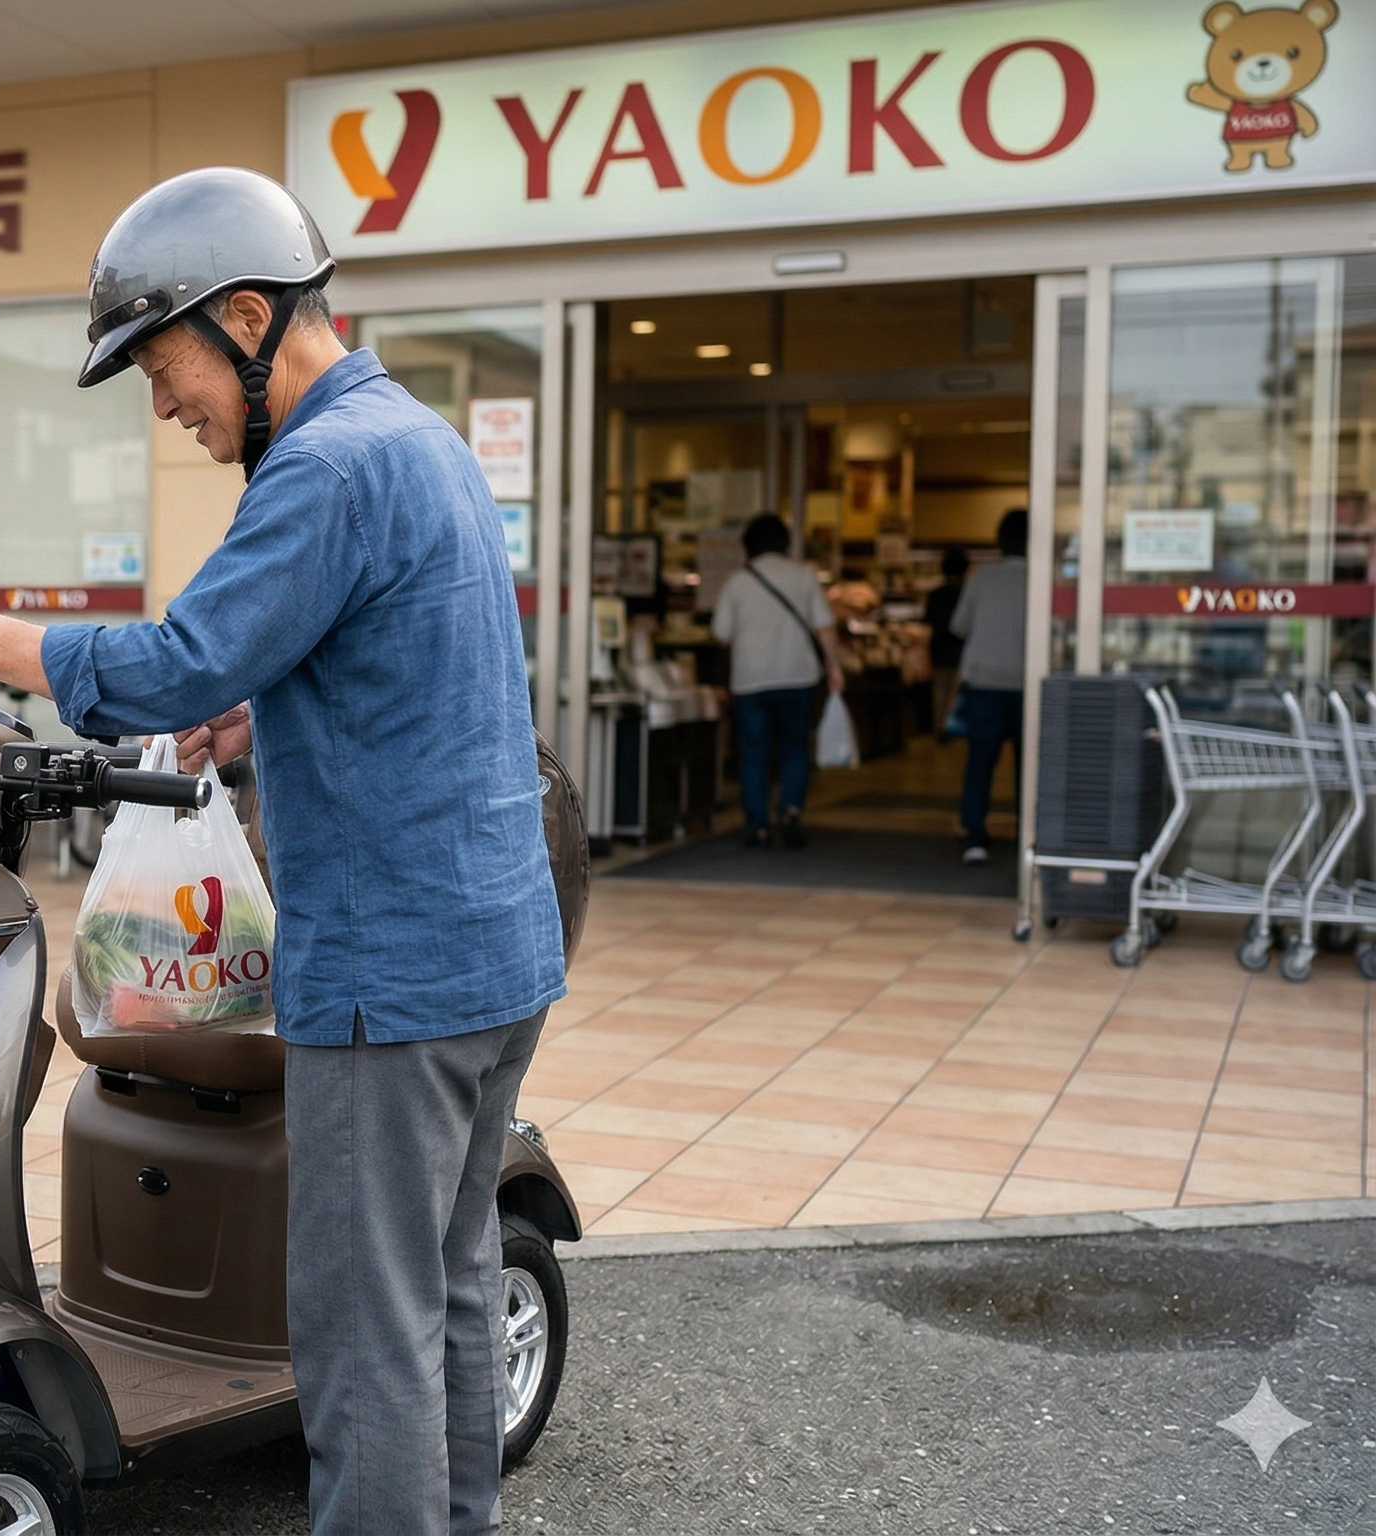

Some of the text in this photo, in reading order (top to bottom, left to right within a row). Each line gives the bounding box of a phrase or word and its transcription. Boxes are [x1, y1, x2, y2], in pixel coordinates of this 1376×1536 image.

[494, 38, 1096, 200] YAOKO
[1202, 587, 1296, 612] YAOKO
[139, 949, 270, 993] YAOKO
